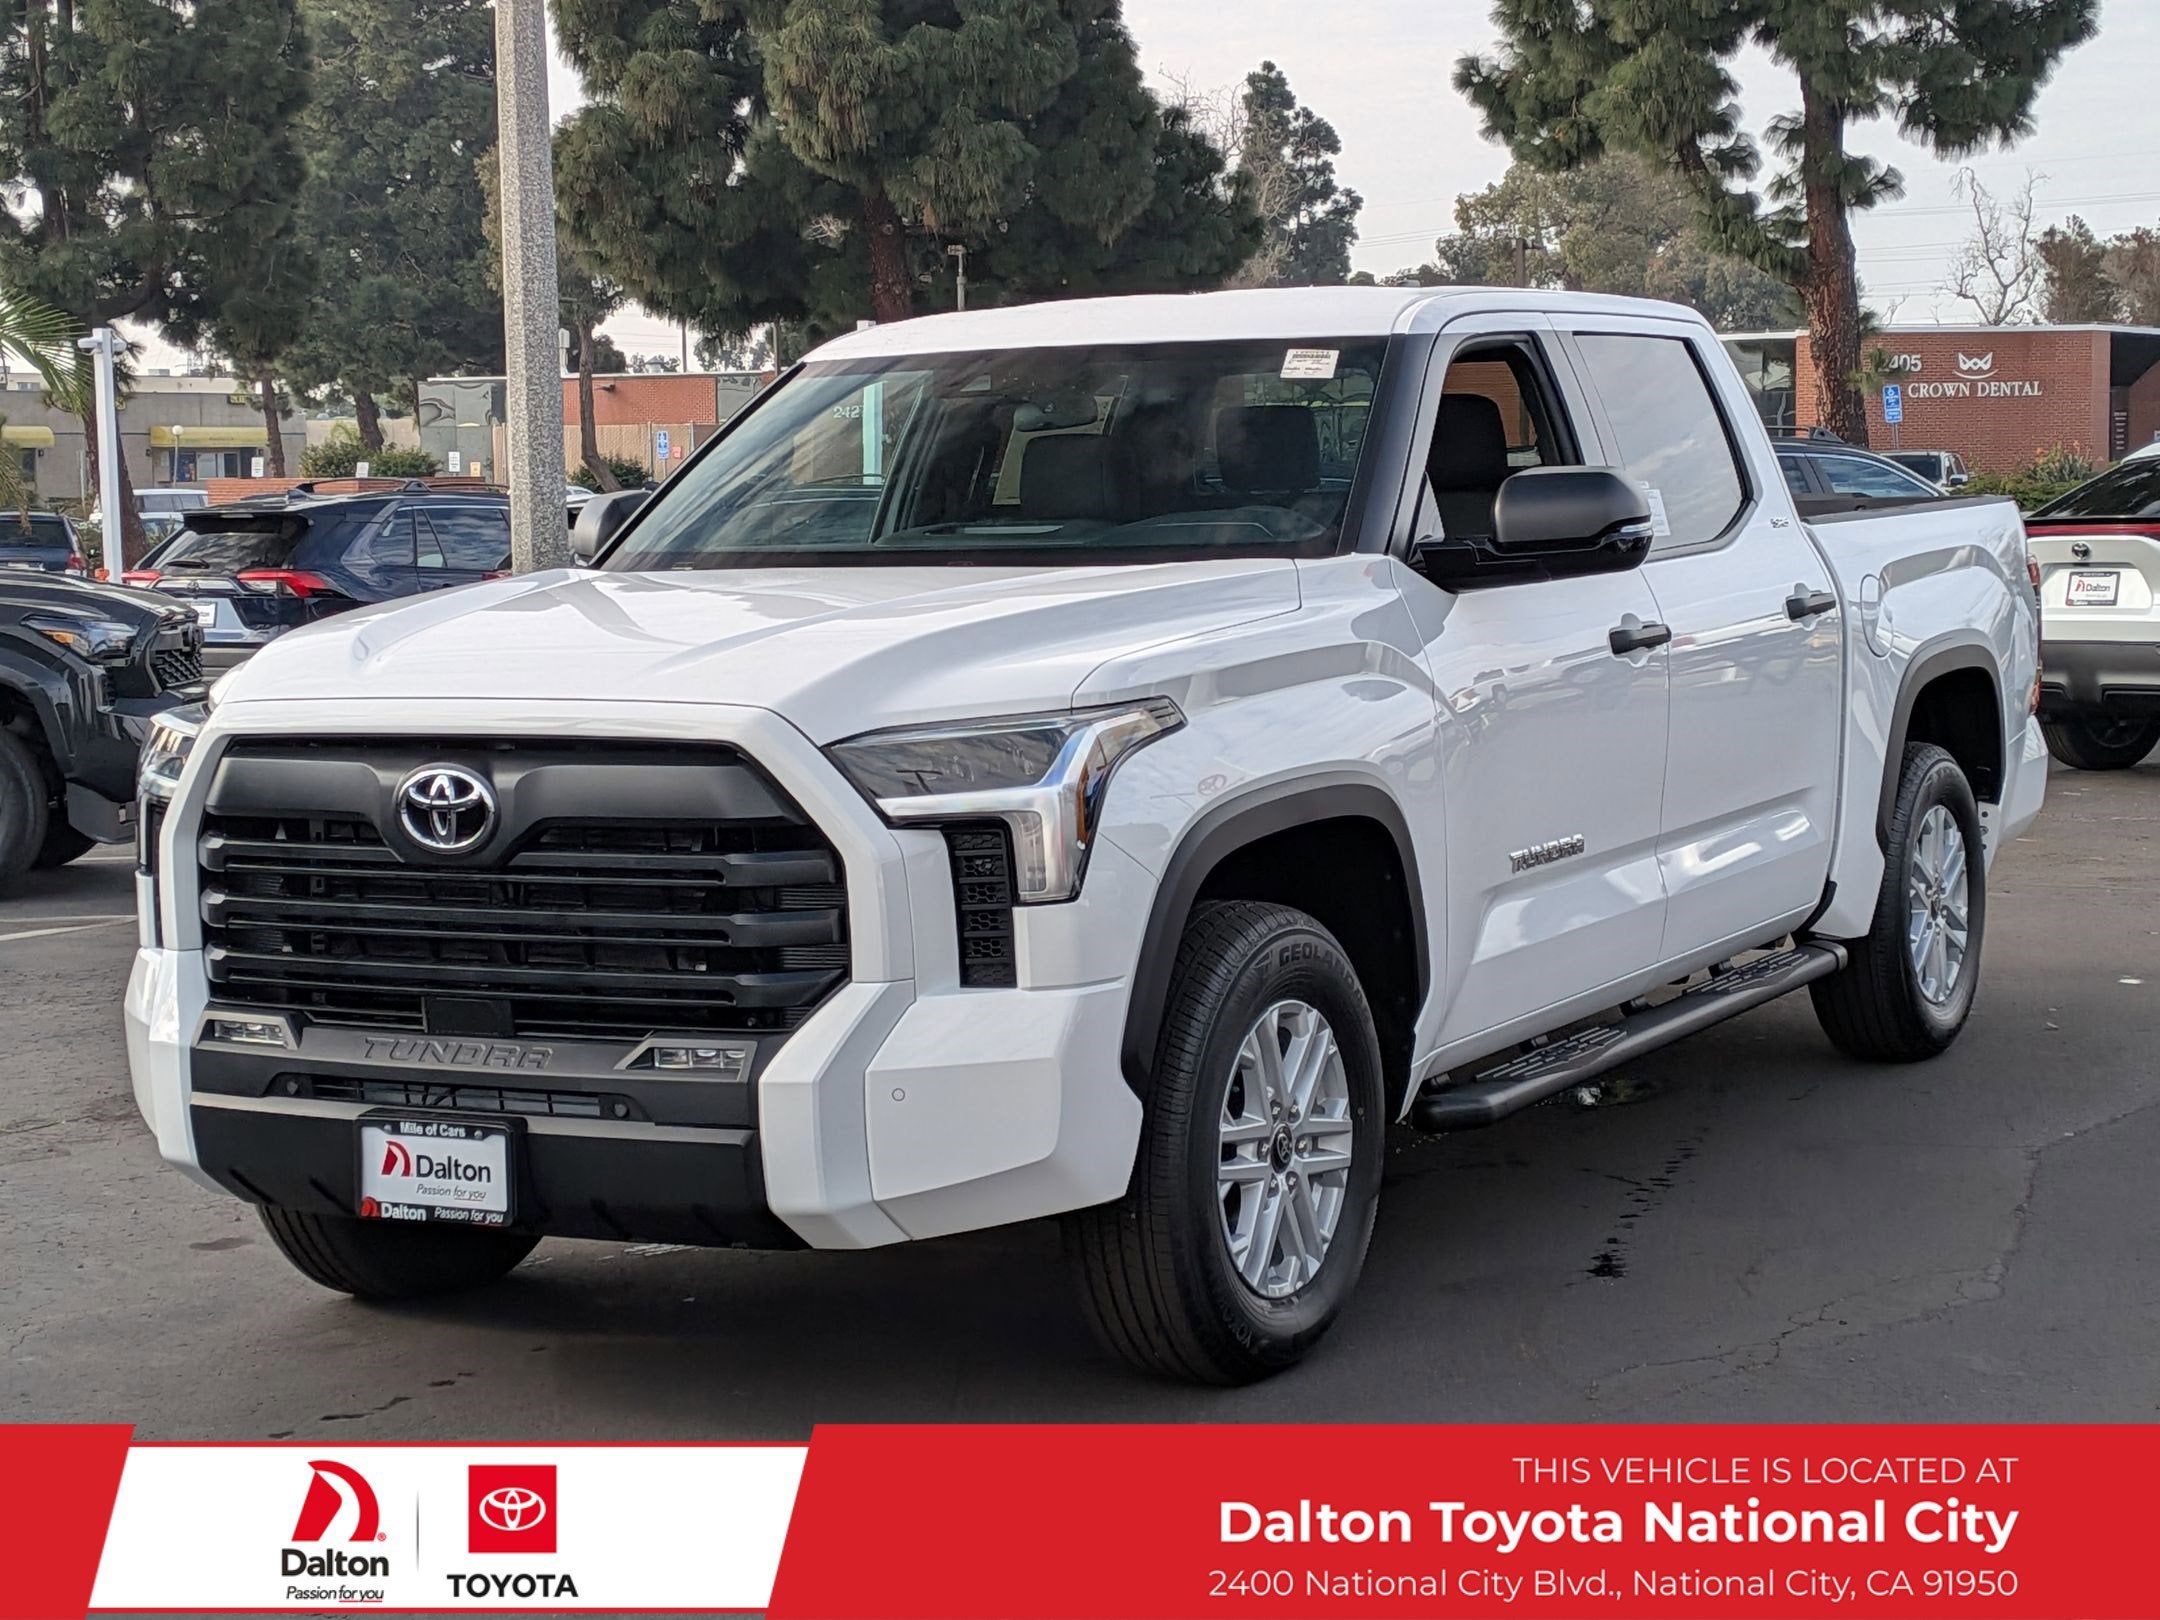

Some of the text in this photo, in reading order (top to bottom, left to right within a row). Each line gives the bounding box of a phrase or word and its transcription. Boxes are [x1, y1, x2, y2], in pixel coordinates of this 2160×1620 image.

[1908, 381, 2042, 398] CROWN DENTAL
[1509, 833, 1585, 874] TUNDRA
[364, 1037, 554, 1069] TUNDRA
[400, 1122, 466, 1137] Mile of Cars
[416, 1154, 491, 1183] Dalton
[416, 1184, 487, 1200] Passion for you
[381, 1203, 504, 1224] Dalton Passion for you
